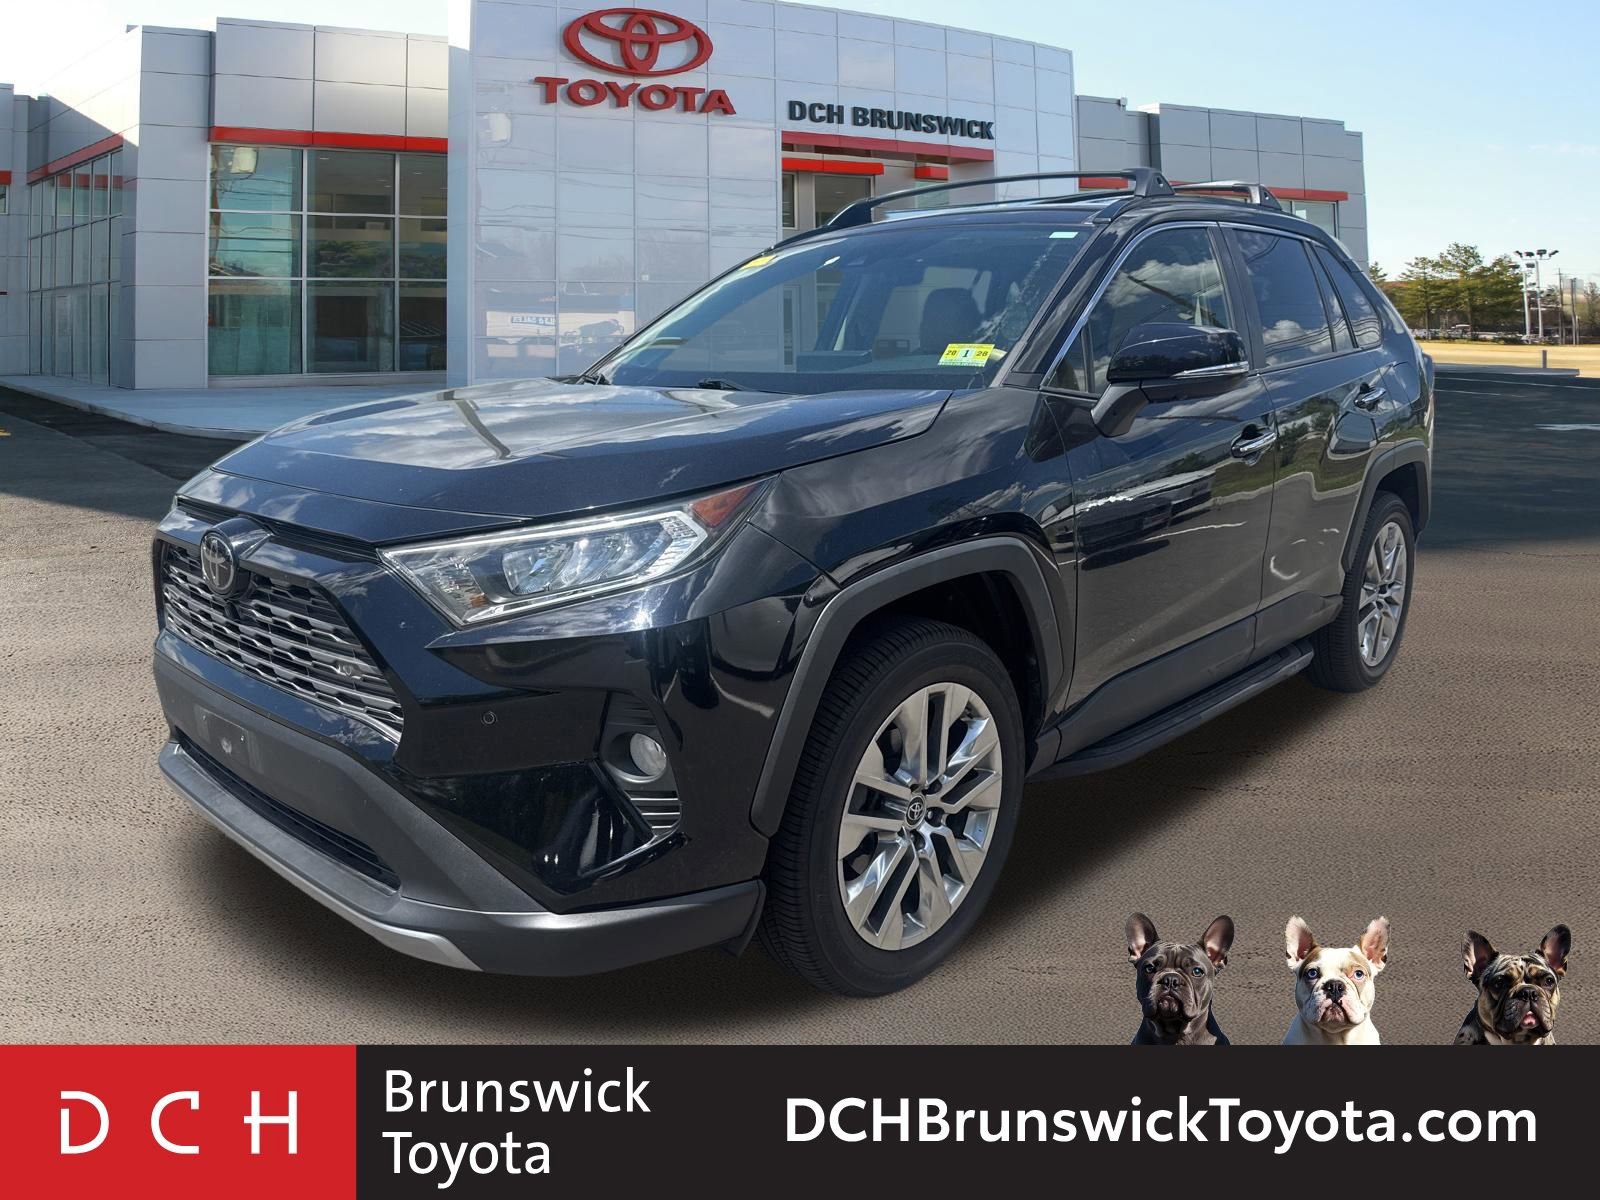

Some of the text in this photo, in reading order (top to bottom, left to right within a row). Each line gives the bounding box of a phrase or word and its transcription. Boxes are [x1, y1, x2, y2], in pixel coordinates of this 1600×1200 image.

[534, 76, 737, 115] TOYOTA
[788, 100, 995, 140] DCH BRUNSWICK
